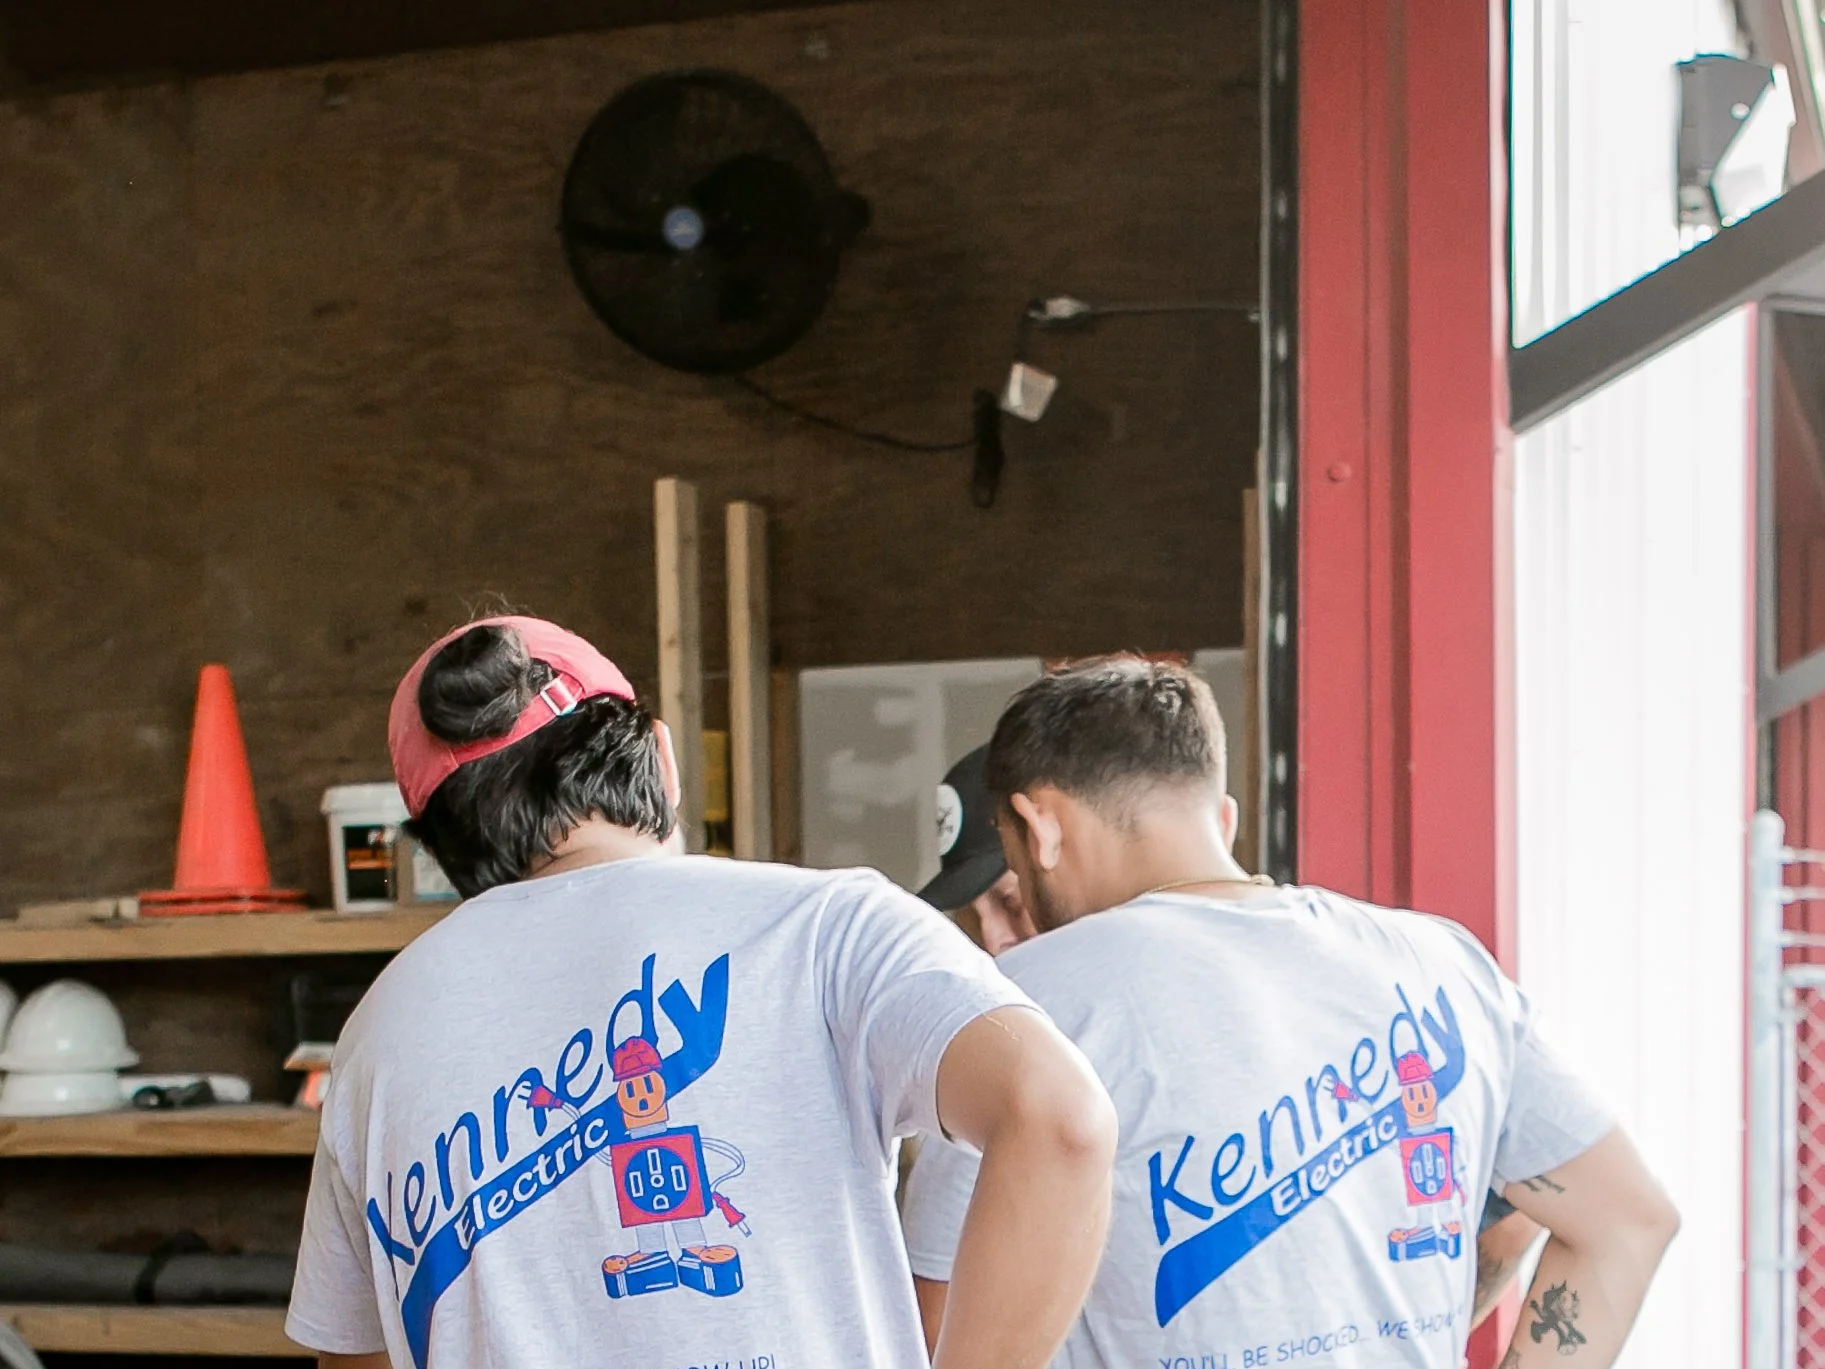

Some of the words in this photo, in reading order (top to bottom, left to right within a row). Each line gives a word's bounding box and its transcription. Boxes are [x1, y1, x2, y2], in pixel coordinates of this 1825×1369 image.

[366, 953, 730, 1301] Kennedy
[1148, 983, 1467, 1246] Kennedy
[1269, 1113, 1399, 1218] Electric
[454, 1116, 609, 1251] Electric
[1243, 1346, 1269, 1369] BE
[1376, 1320, 1409, 1340] WE
